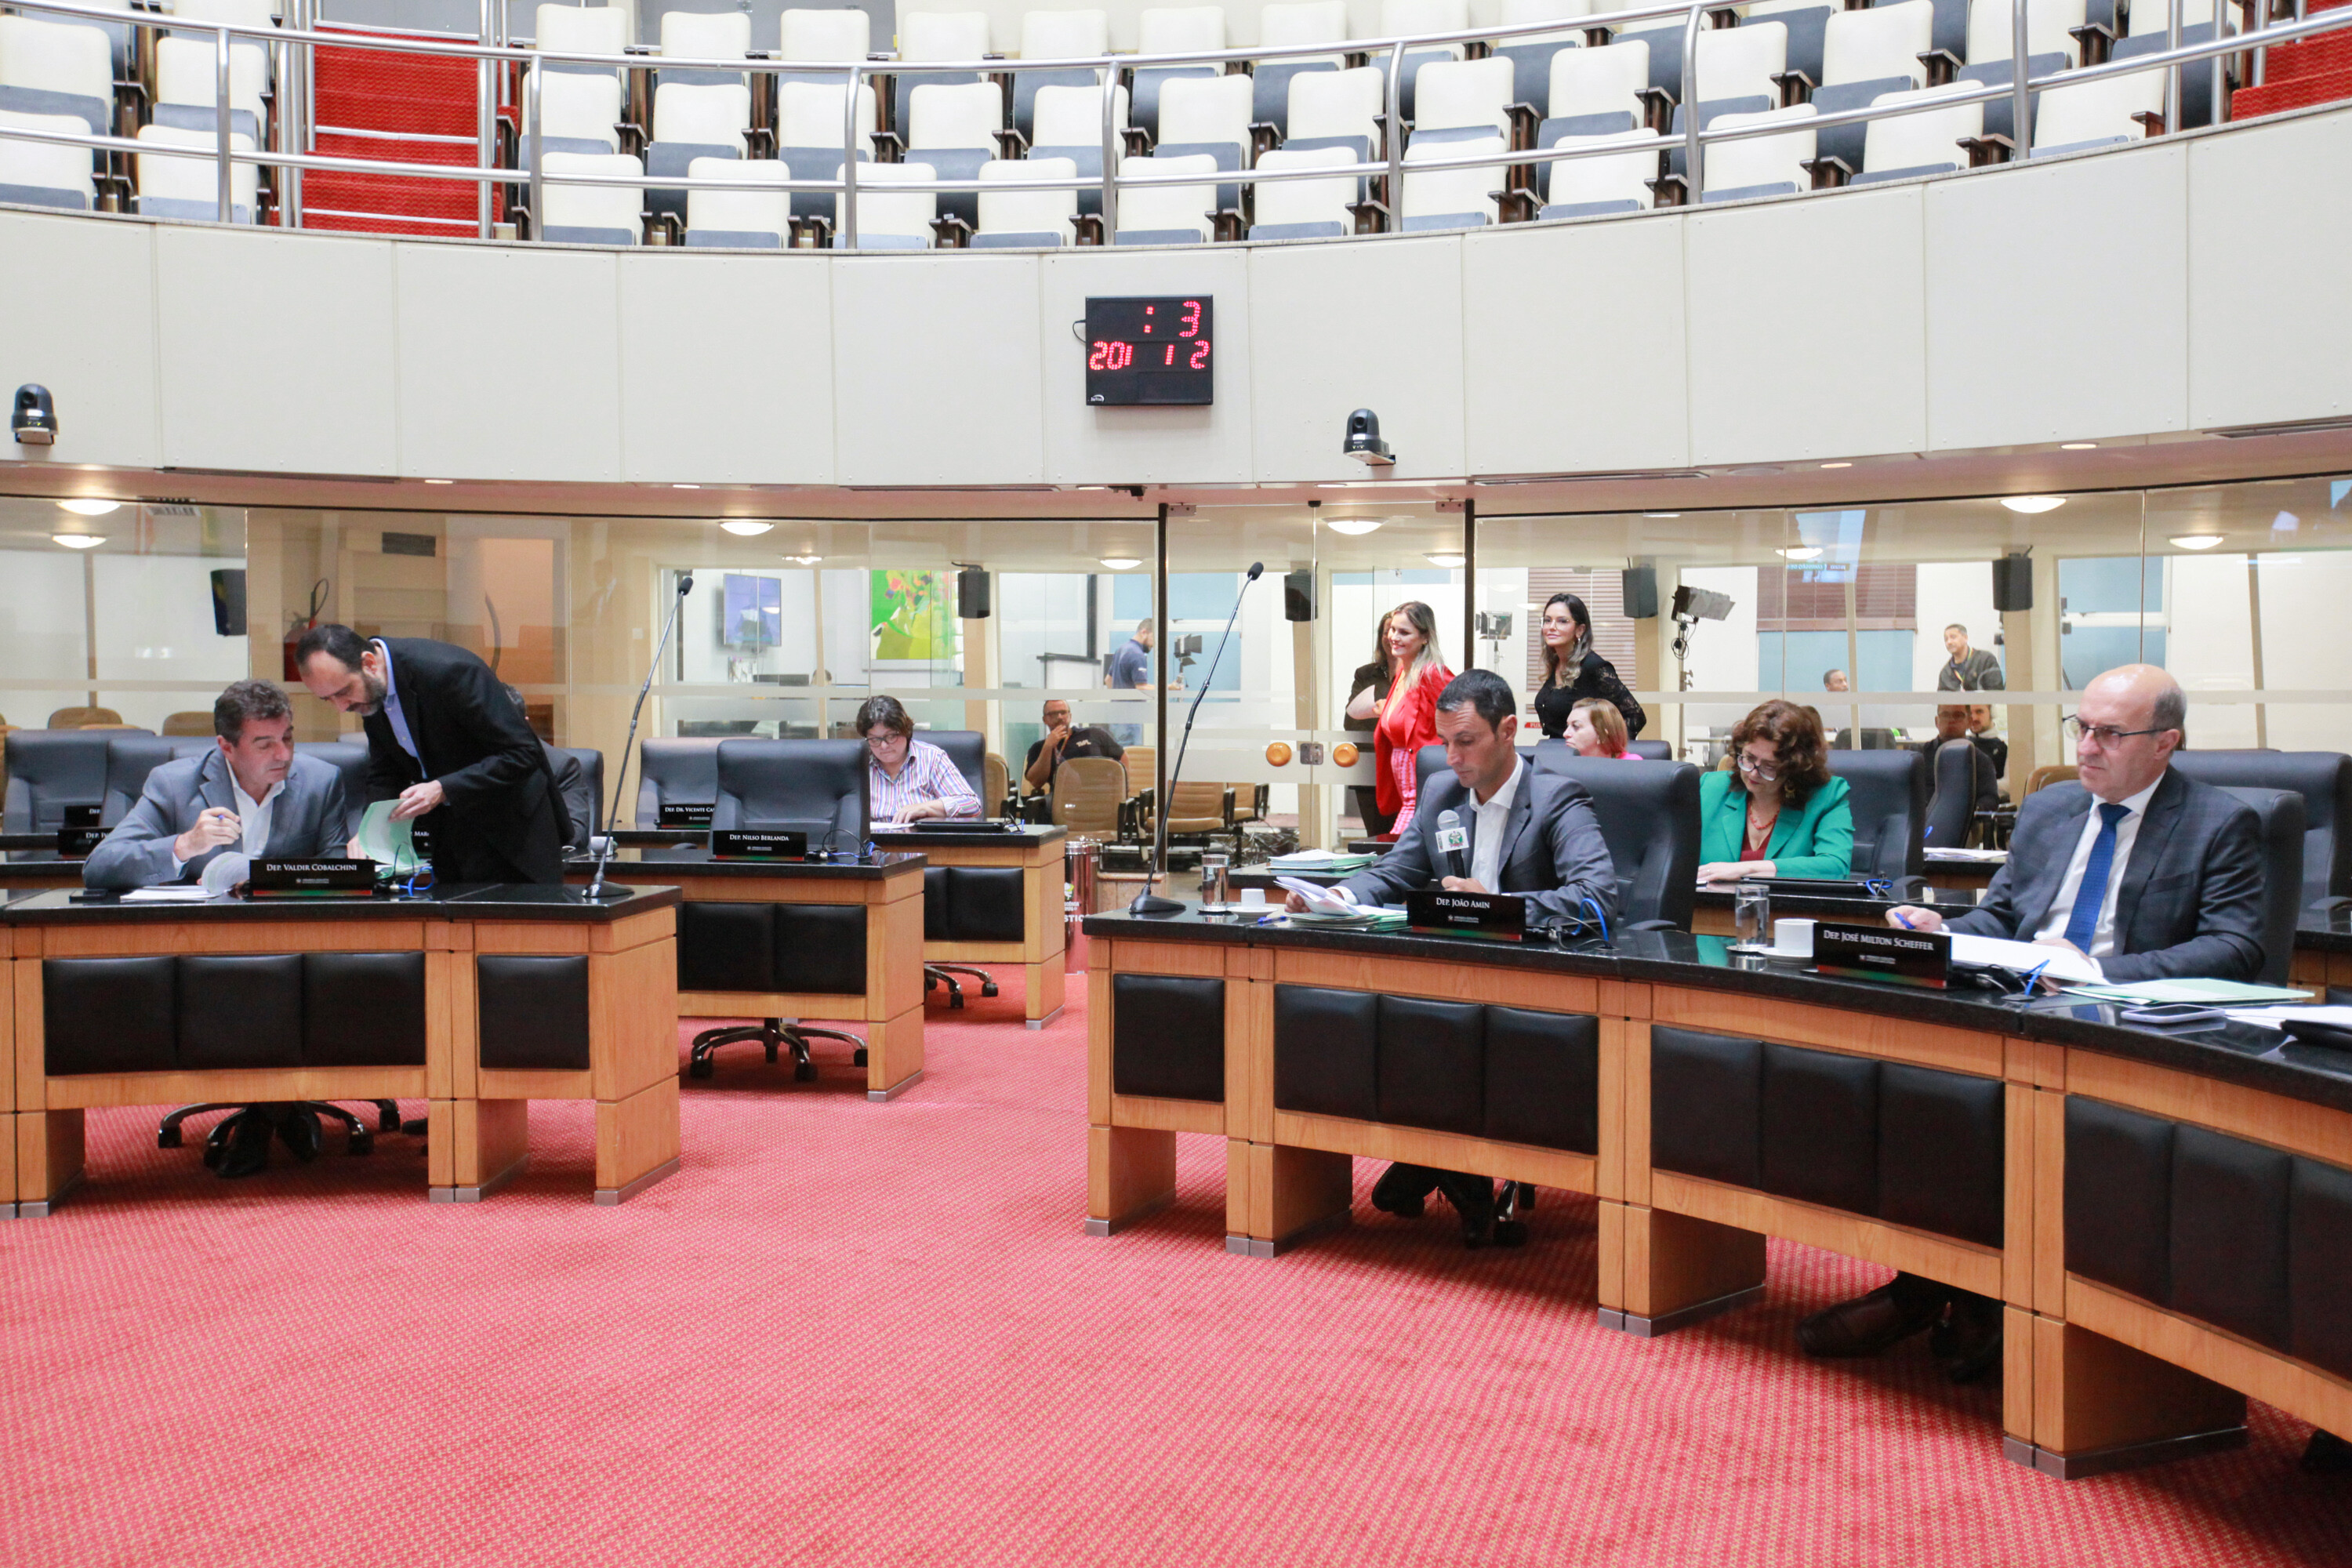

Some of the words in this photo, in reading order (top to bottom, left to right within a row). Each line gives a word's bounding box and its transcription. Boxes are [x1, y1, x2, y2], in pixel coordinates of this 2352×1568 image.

[1190, 340, 1210, 369] 2
[1452, 898, 1469, 908] JOÃO
[1842, 932, 1859, 942] JOSÉ
[1860, 935, 1893, 946] MILTON
[1893, 938, 1934, 950] SCHEFFER
